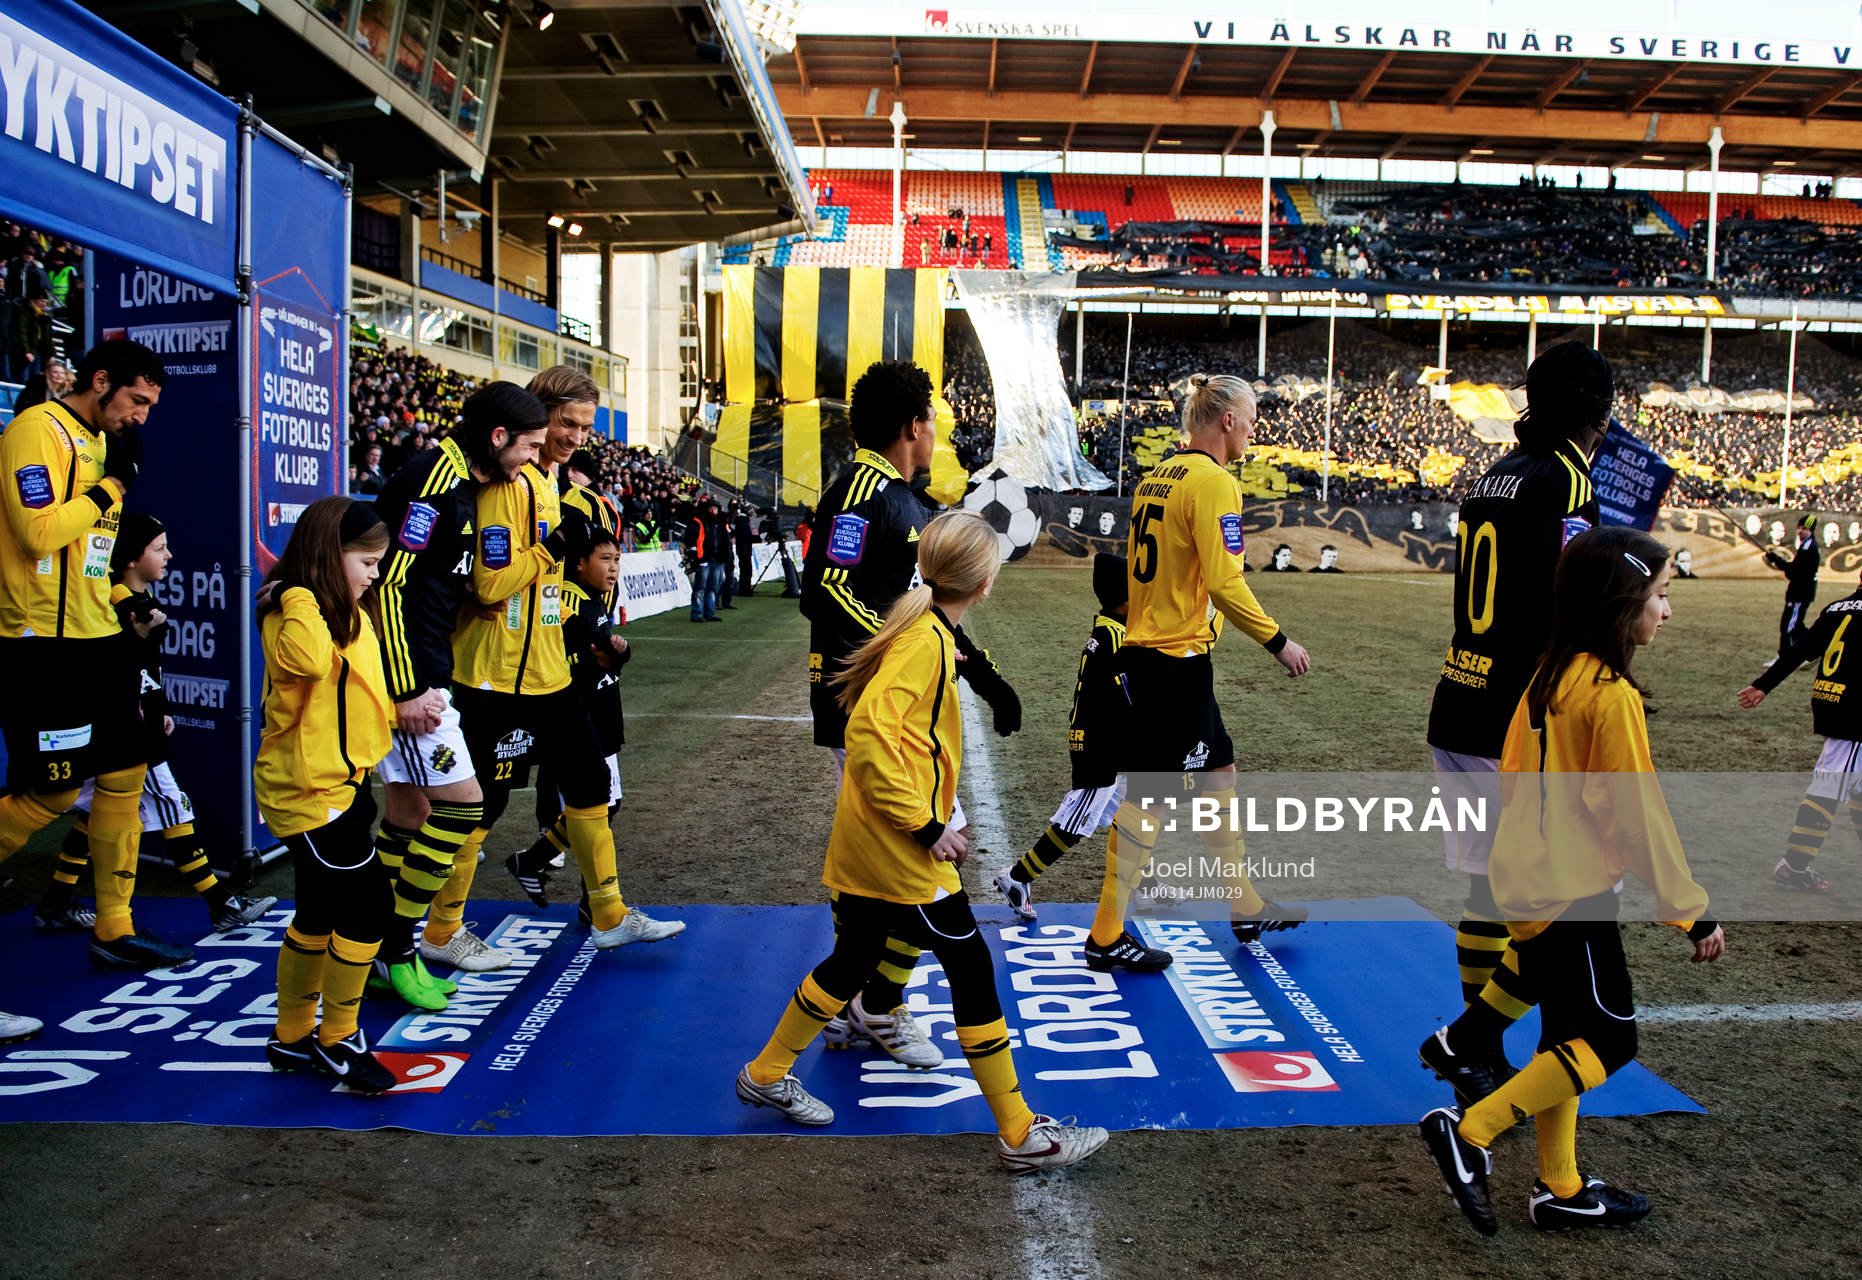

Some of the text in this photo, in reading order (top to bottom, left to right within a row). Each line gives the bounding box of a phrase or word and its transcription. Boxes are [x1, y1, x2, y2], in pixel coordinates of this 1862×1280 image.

[955, 22, 1081, 37] SVENSKA SPEL
[1194, 21, 1234, 39] VI
[1270, 18, 1451, 48] ÄLSKAR
[1487, 28, 1573, 52] NÄR
[1609, 37, 1800, 62] SVERIGE
[280, 337, 314, 376] HELA
[263, 371, 329, 416] SVERIGES
[262, 410, 331, 451] FOTBOLLS
[275, 452, 319, 486] KLUBB
[867, 453, 895, 473] stadium
[1599, 454, 1656, 488] SVERIGES
[1617, 447, 1648, 470] HELA
[1591, 467, 1652, 501] FOTBOLLS
[1596, 484, 1637, 508] KLUBB
[1131, 503, 1164, 584] 15
[192, 562, 226, 610] PÅ
[1822, 614, 1852, 677] 6
[48, 761, 72, 781] 33
[495, 761, 513, 780] 22
[1182, 772, 1196, 790] 15
[1144, 919, 1286, 1043] STRYKTIPSET
[999, 924, 1160, 1081] LÖRDAG
[1284, 991, 1340, 1035] SVERIGES
[488, 1043, 531, 1071] HELA
[511, 998, 564, 1042] SVERIGES
[1322, 1036, 1365, 1063] HELA
